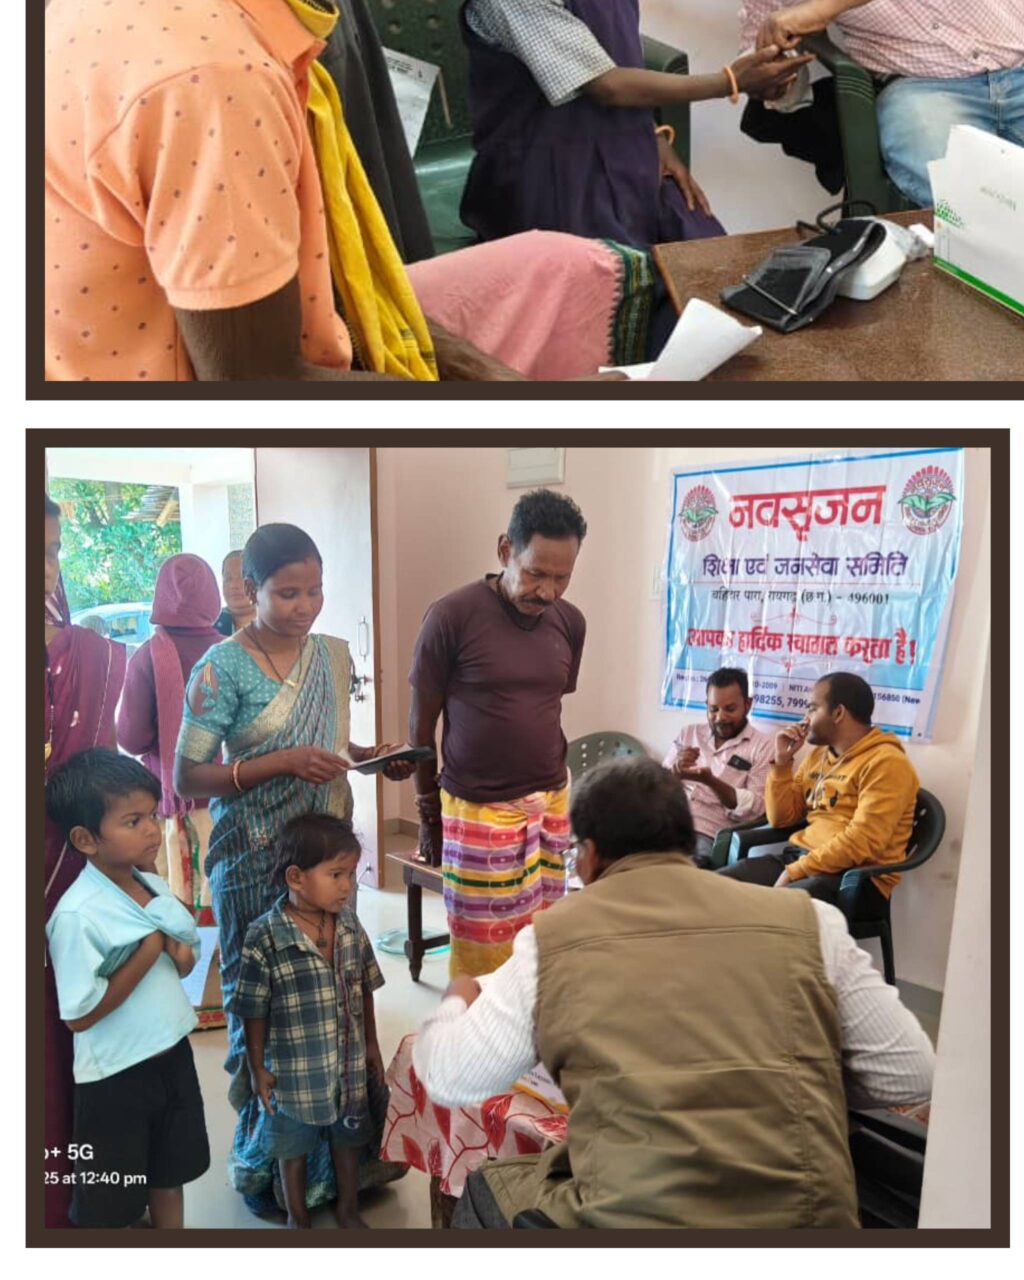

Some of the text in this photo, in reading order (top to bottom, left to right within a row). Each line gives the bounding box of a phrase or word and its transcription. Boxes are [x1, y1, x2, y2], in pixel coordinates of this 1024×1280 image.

[728, 484, 887, 542] नवसृजन
[774, 552, 840, 577] जनसेवा
[846, 550, 909, 577] समिति
